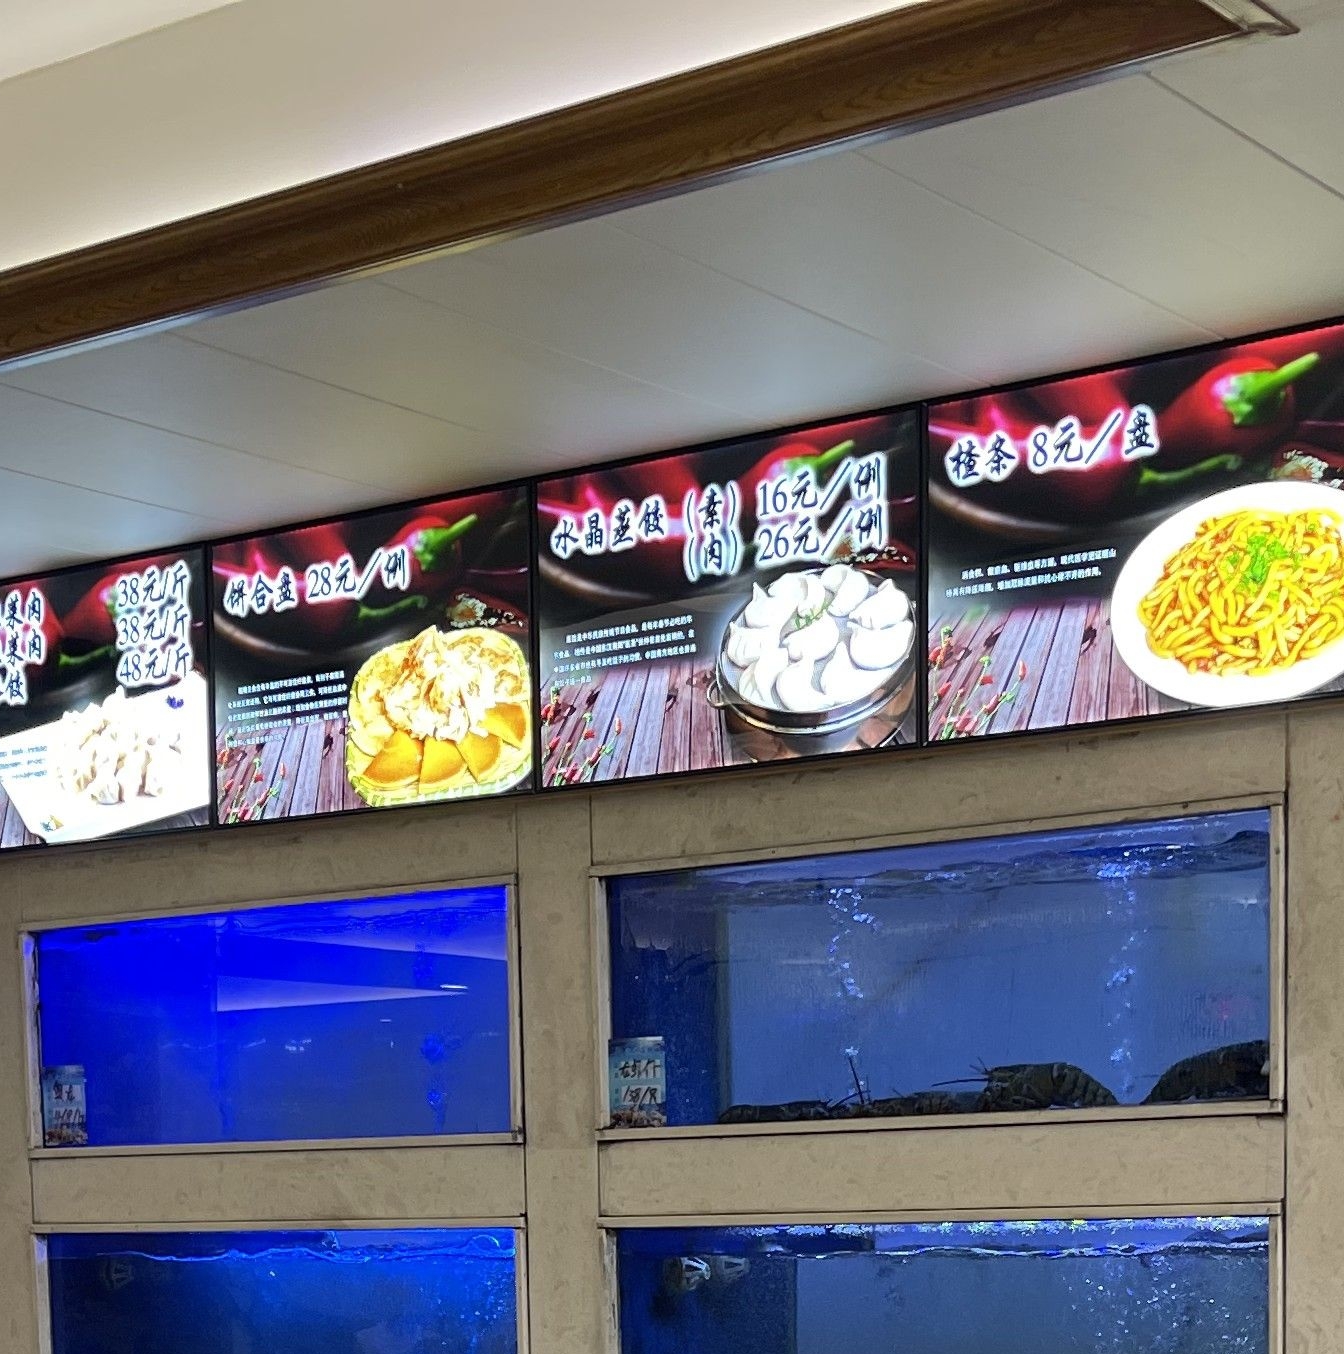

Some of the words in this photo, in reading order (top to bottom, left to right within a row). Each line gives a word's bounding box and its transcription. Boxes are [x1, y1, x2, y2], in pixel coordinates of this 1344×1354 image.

[1032, 408, 1155, 468] 8元/盘
[554, 499, 666, 555] 水晶蒸饺
[117, 565, 190, 609] 38元/斤
[118, 603, 191, 647] 38元/斤
[118, 642, 192, 683] 48元/斤
